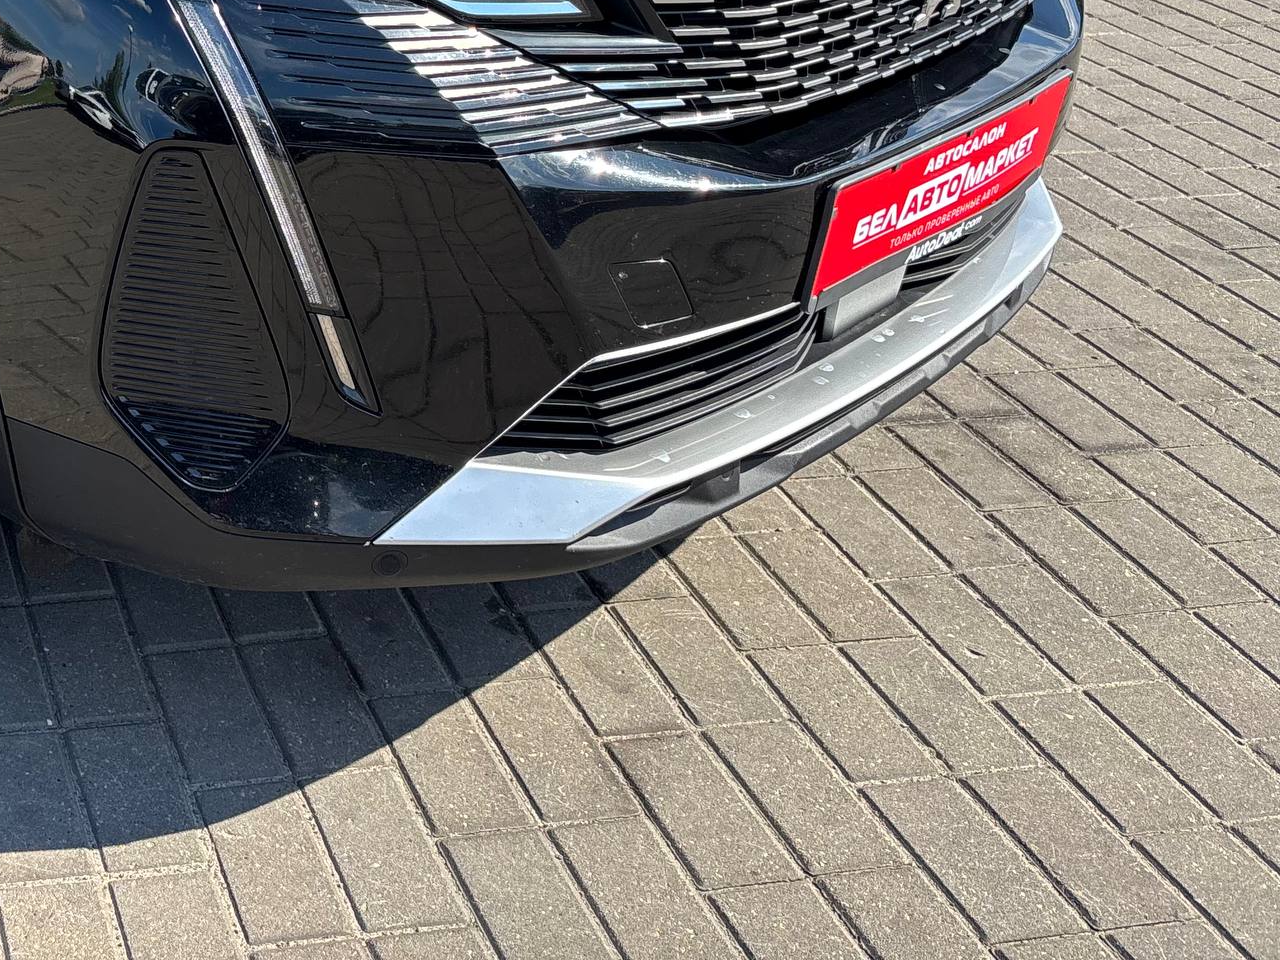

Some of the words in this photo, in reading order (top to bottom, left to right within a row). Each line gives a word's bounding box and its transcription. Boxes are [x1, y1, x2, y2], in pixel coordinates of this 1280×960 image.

[924, 122, 1007, 176] АВТОСАЛОН
[890, 225, 924, 248] ТОЛЬКО
[924, 195, 981, 232] ПРОВЕРЕННЫЕ
[980, 184, 1000, 202] АВТО
